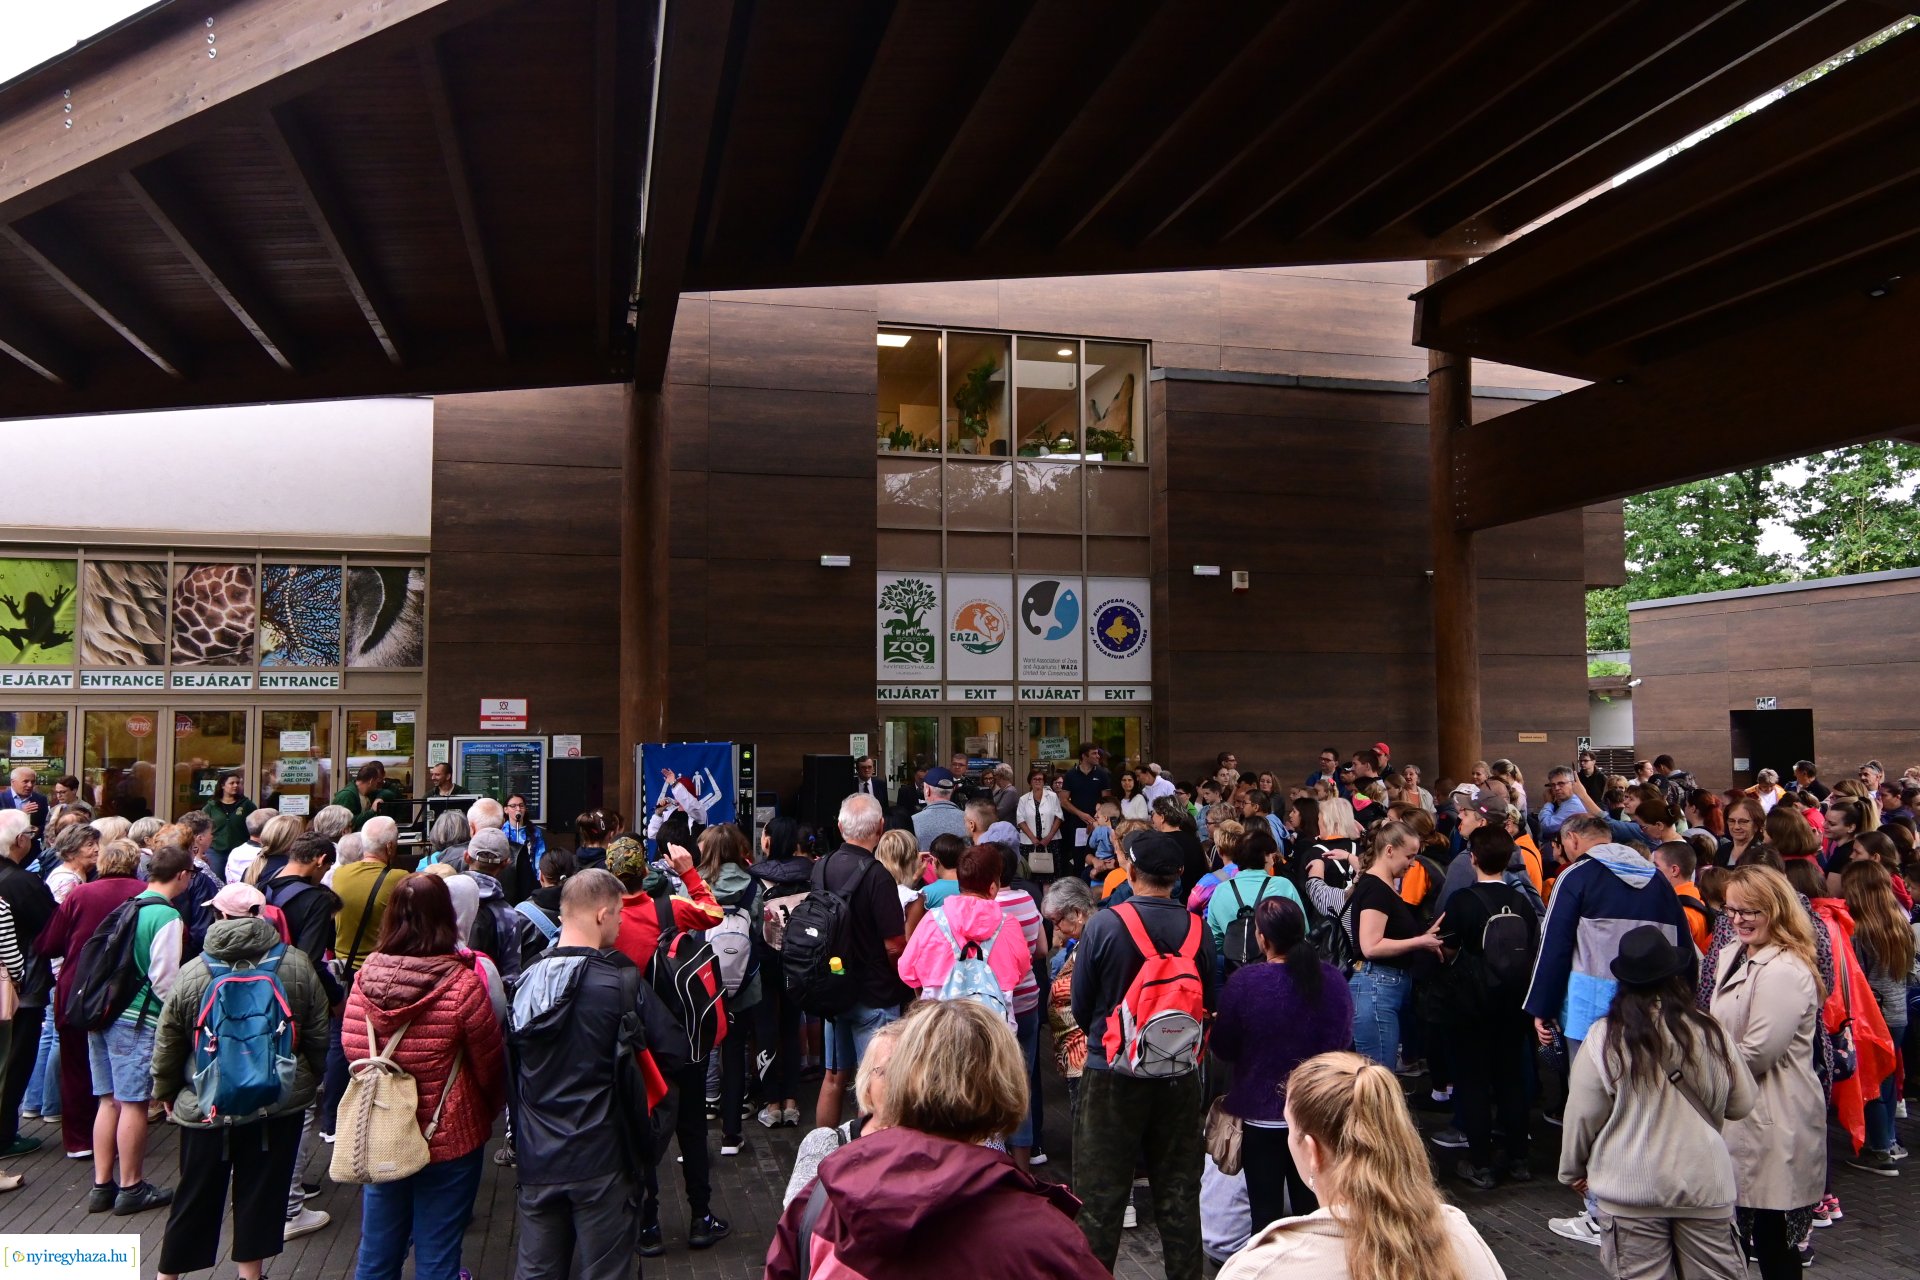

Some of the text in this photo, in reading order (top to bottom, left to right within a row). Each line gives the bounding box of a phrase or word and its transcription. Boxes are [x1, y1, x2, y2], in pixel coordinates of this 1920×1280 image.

[1093, 598, 1145, 618] EUROPEAN UNION
[950, 632, 979, 642] EAZA
[1089, 626, 1148, 660] OF AQUARIUM CURATORS
[888, 641, 930, 653] ZOO
[0, 672, 72, 686] EJÁRAT
[80, 675, 164, 687] ENTRANCE
[172, 673, 252, 687] BEJÁRAT
[259, 676, 339, 688] ENTRANCE
[877, 686, 940, 699] KIJÁRAT
[964, 689, 997, 699] EXIT
[1021, 687, 1081, 699] KIJÁRAT
[1104, 689, 1136, 699] EXIT
